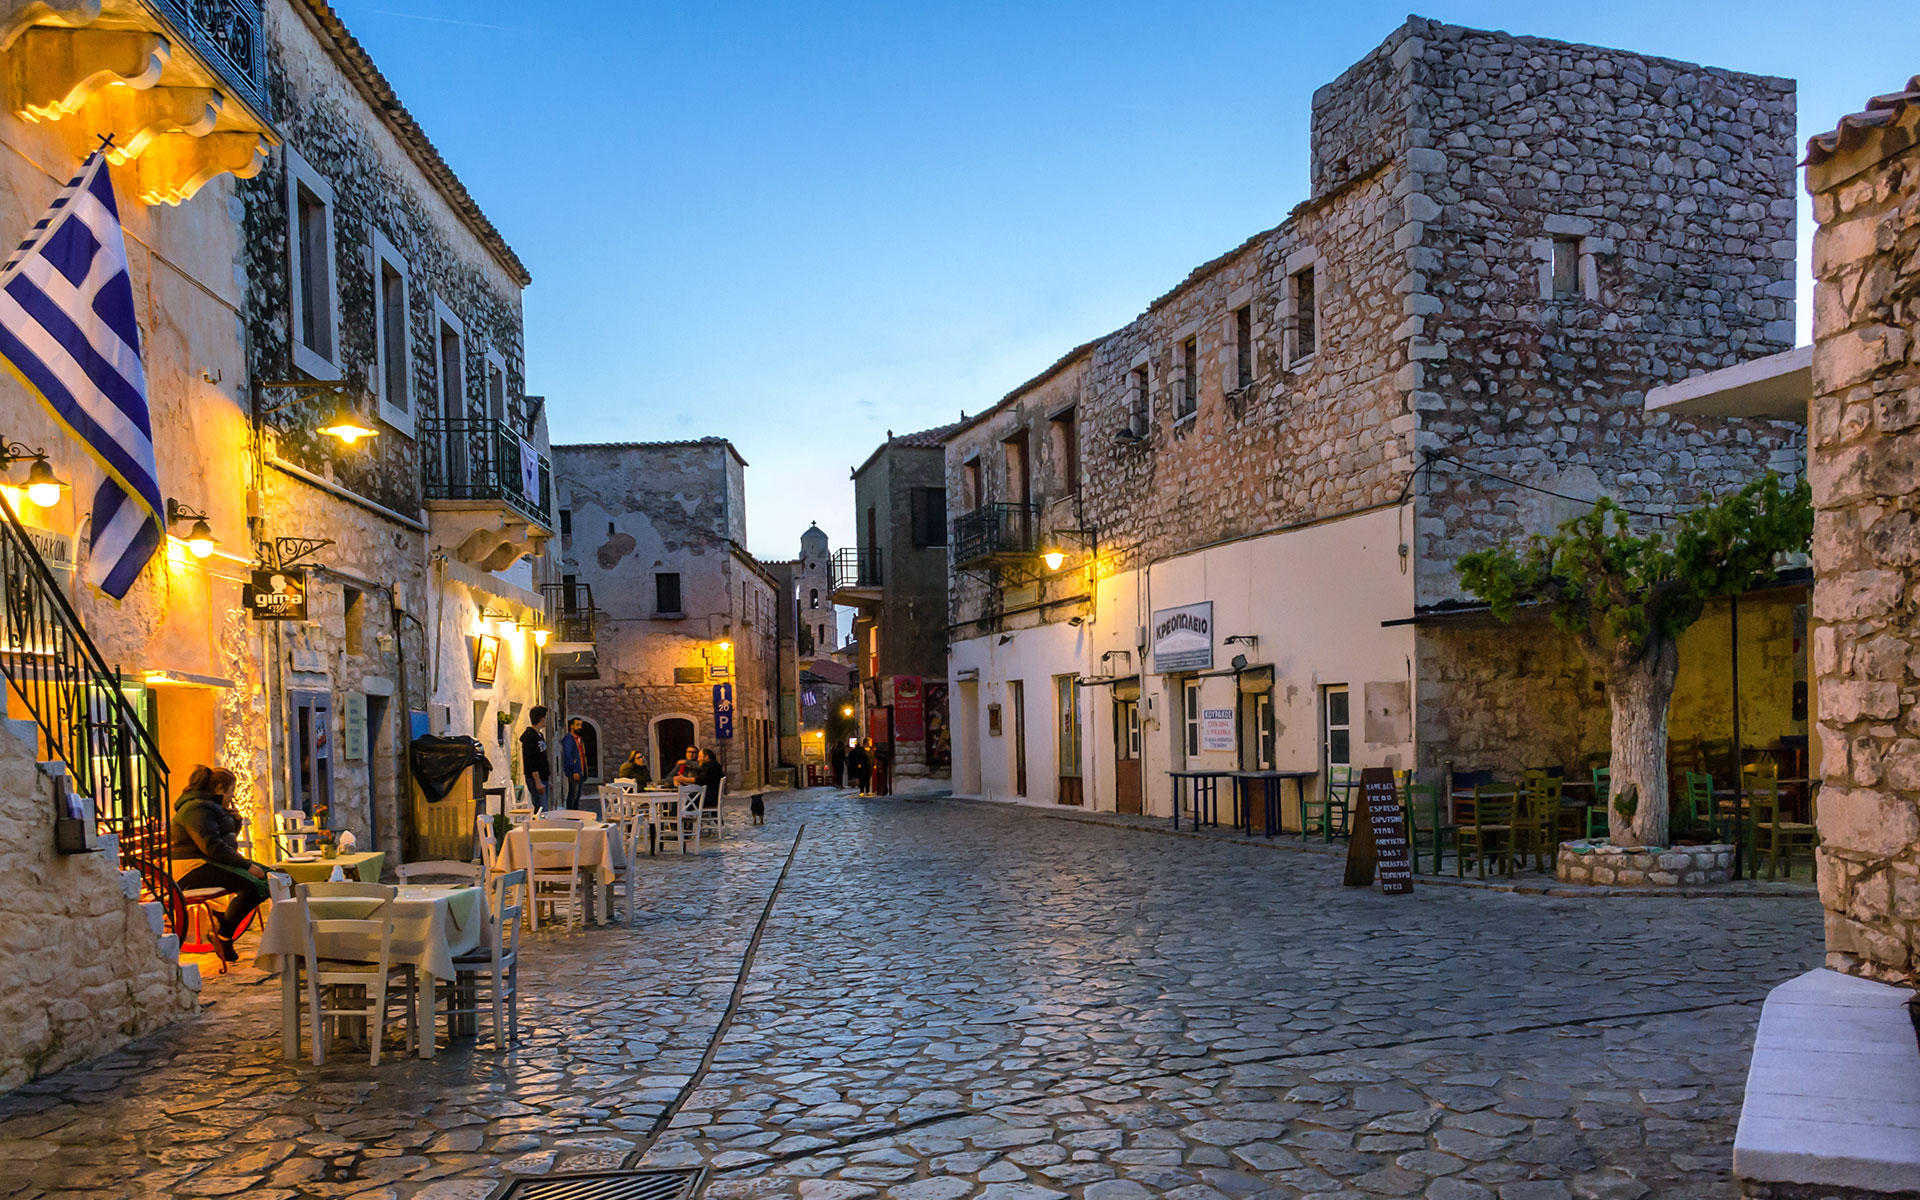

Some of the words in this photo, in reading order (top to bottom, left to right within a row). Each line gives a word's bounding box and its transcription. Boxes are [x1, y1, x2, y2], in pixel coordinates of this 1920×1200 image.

[255, 594, 302, 607] gima
[1156, 613, 1208, 640] ΚΡΕΟΠΩΛΕΙΟ
[718, 703, 730, 712] 20
[719, 715, 729, 729] P
[1377, 849, 1401, 857] TOAST
[1379, 860, 1410, 868] BREAKFAST
